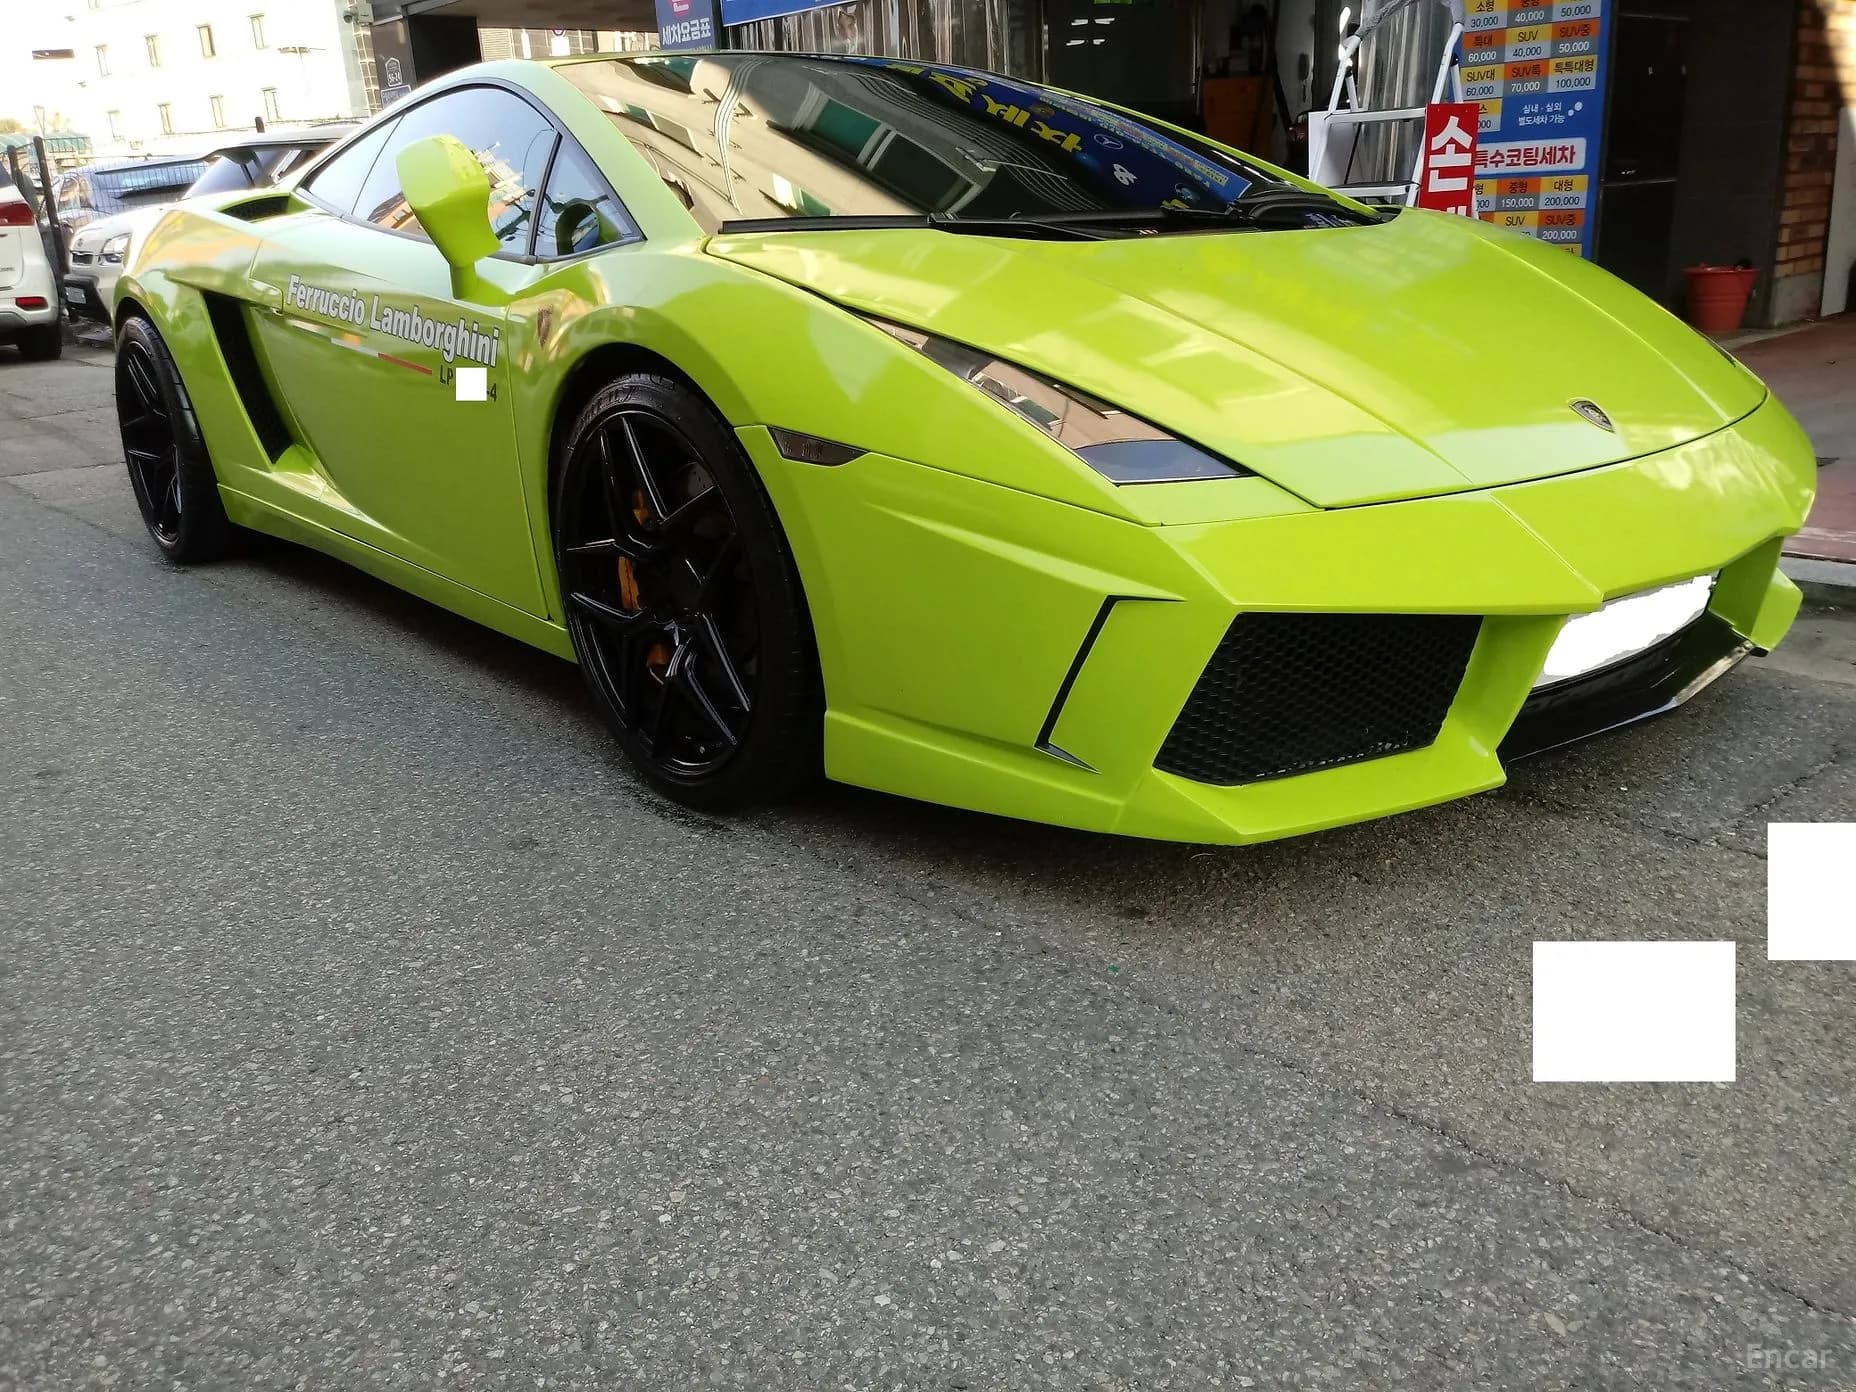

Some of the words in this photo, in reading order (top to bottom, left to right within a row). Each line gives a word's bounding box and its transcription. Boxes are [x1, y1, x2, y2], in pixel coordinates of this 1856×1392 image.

[1475, 0, 1494, 13] 소형
[1471, 16, 1498, 28] 30,000
[1515, 11, 1544, 23] 40,000
[1561, 5, 1591, 17] 50,000
[662, 17, 711, 46] 세차요금표
[1518, 31, 1538, 42] SUV
[1468, 51, 1496, 63] 60,000
[1513, 46, 1541, 58] 40,000
[1559, 41, 1589, 53] 50,000
[1467, 69, 1495, 82] SUV대
[1466, 86, 1494, 97] 60,000
[1511, 82, 1540, 93] 70,000
[1556, 77, 1590, 89] 100,000
[1475, 145, 1576, 168] 특수코팅세차
[1509, 181, 1528, 194] 중형
[1553, 179, 1573, 192] 대형
[1502, 198, 1534, 208] 150,000
[1544, 196, 1580, 207] 200,000
[1505, 216, 1525, 226] SUV
[1542, 230, 1577, 240] 200,000
[286, 274, 365, 326] Ferruccio
[370, 294, 500, 368] Lamborghini
[439, 364, 454, 385] LP
